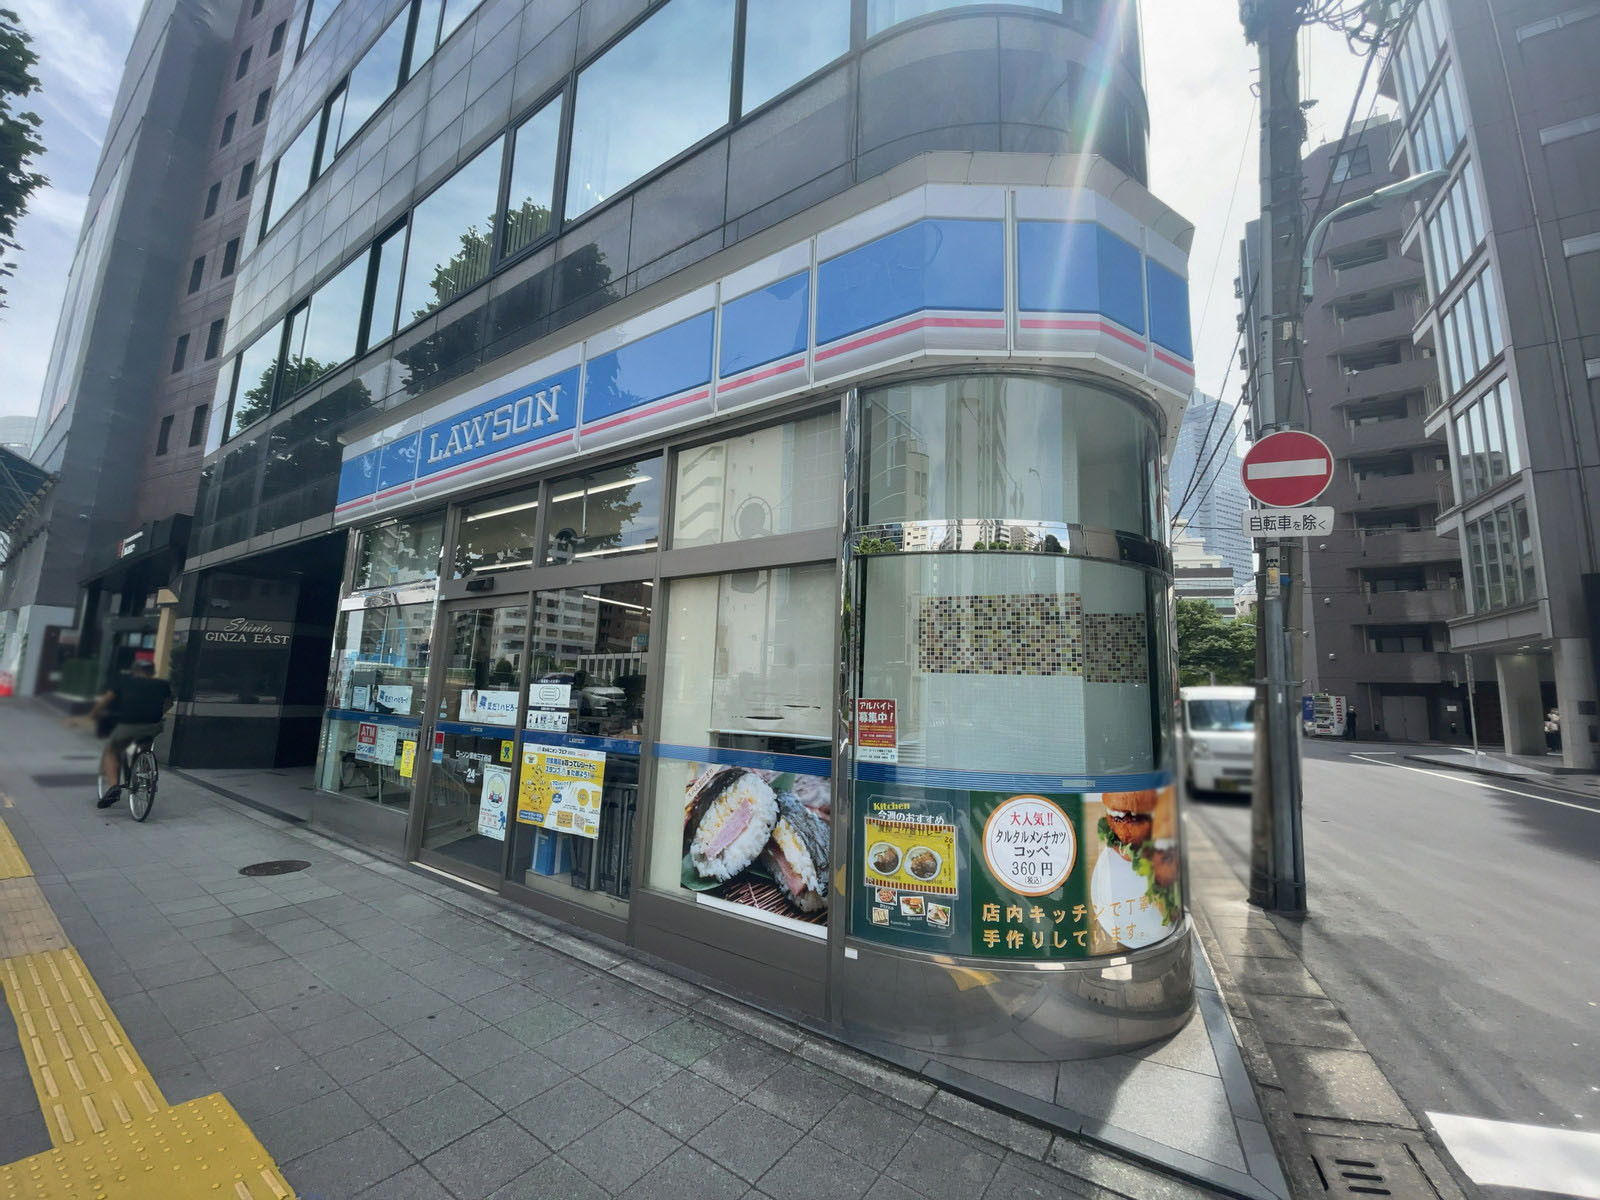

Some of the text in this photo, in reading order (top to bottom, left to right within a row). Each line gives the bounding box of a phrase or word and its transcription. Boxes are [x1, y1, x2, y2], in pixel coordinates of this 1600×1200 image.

[427, 384, 562, 464] LAWSON
[1250, 514, 1326, 531] 自転車を除く
[223, 617, 273, 633] Shinto
[205, 632, 290, 645] GINZA EAST
[860, 702, 893, 710] アルバイト
[1335, 697, 1344, 725] KIRIN
[859, 711, 894, 723] 募集中!
[361, 725, 375, 738] ATM
[466, 768, 476, 780] 24
[873, 802, 910, 810] Kitchen
[878, 809, 945, 825] 今週のおすすめ
[996, 829, 1066, 844] タルタルメンチカツ
[1014, 846, 1050, 857] コッペ
[1012, 861, 1053, 877] 360 円
[982, 923, 1145, 949] 手作りしています。
